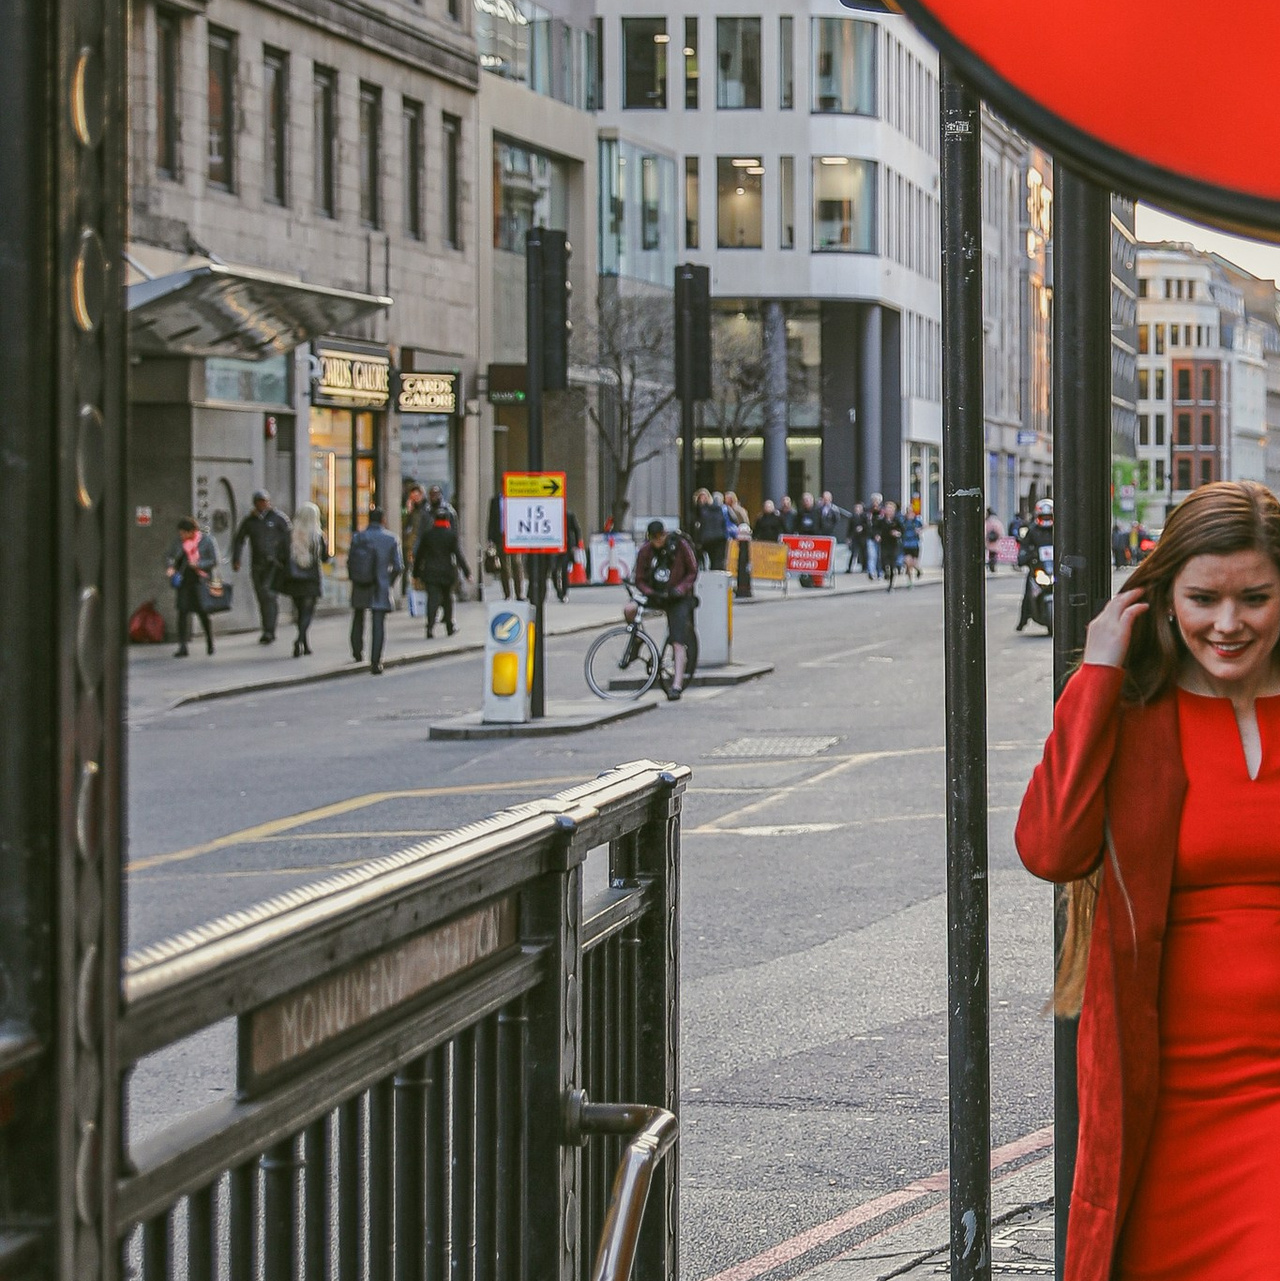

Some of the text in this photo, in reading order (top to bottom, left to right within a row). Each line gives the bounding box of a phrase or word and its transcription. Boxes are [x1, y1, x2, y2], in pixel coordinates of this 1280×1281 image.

[402, 377, 452, 394] CARDS
[399, 391, 456, 409] GALORE
[282, 951, 404, 1061] MONUMENT
